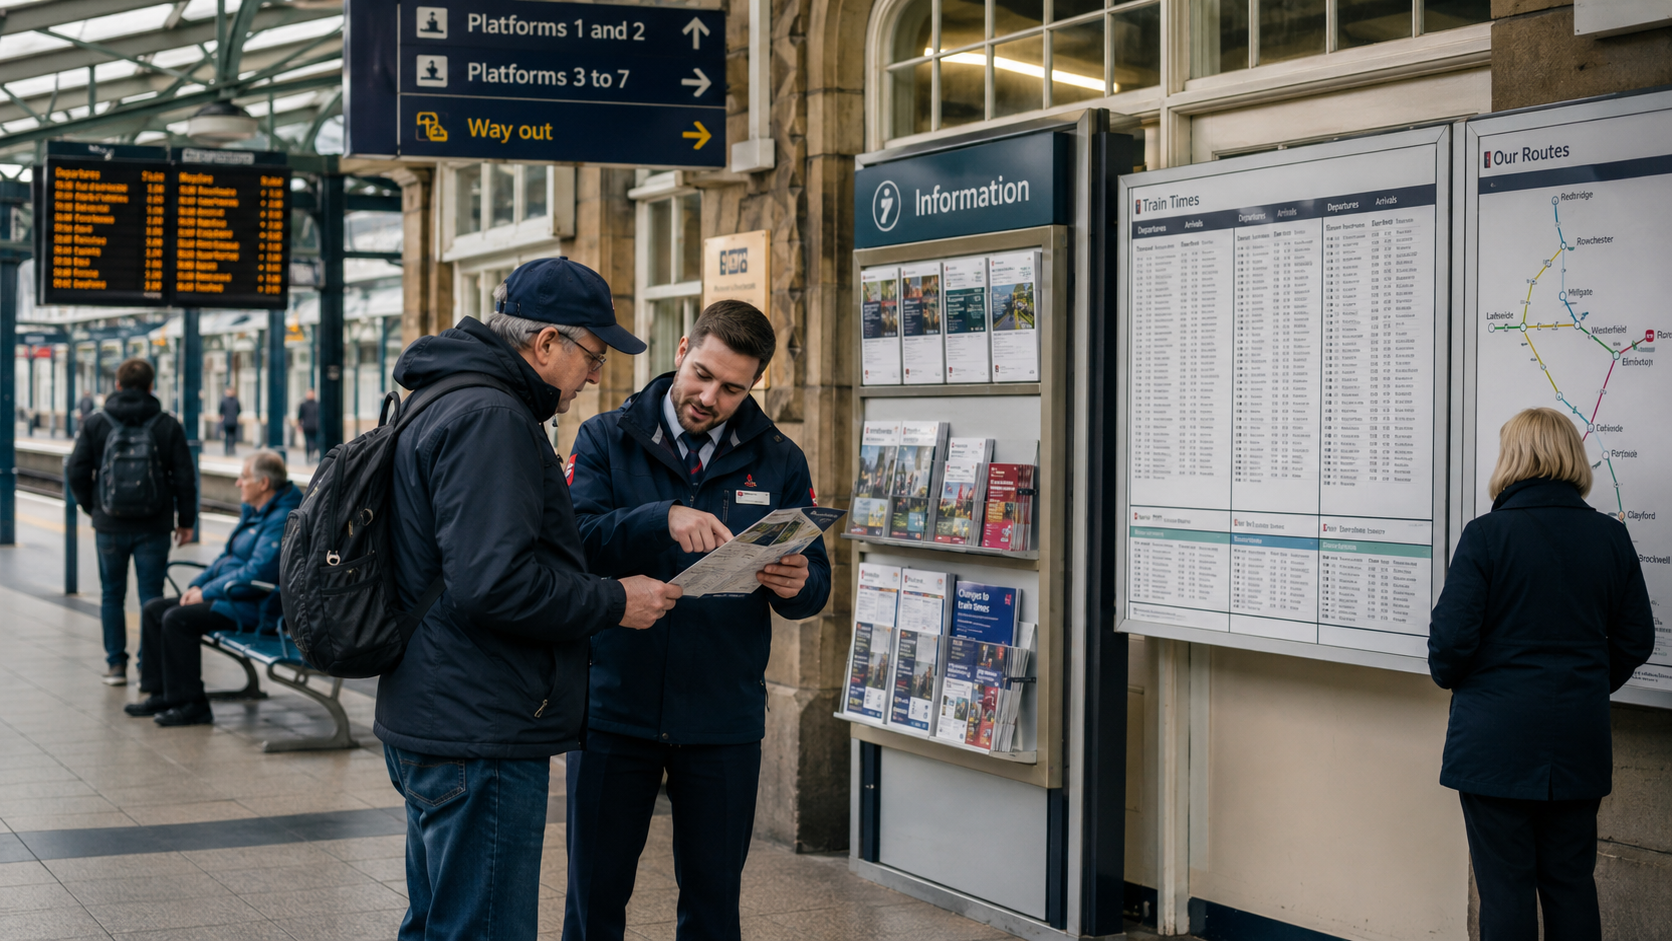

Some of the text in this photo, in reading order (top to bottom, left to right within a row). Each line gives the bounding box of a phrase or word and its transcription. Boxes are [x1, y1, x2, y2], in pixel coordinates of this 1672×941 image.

[468, 13, 645, 41] Platforms 1 and 2
[468, 63, 630, 89] Platforms 3 to 7
[467, 118, 553, 144] Way out
[1494, 145, 1570, 166] Our Routes
[915, 175, 1030, 217] Information
[1143, 194, 1200, 212] Train Times
[1327, 195, 1398, 213] Departures Arrivals
[1238, 207, 1298, 223] Departures Arrivals
[1138, 219, 1204, 235] Departures Arrivals
[1627, 510, 1656, 521] Clayford
